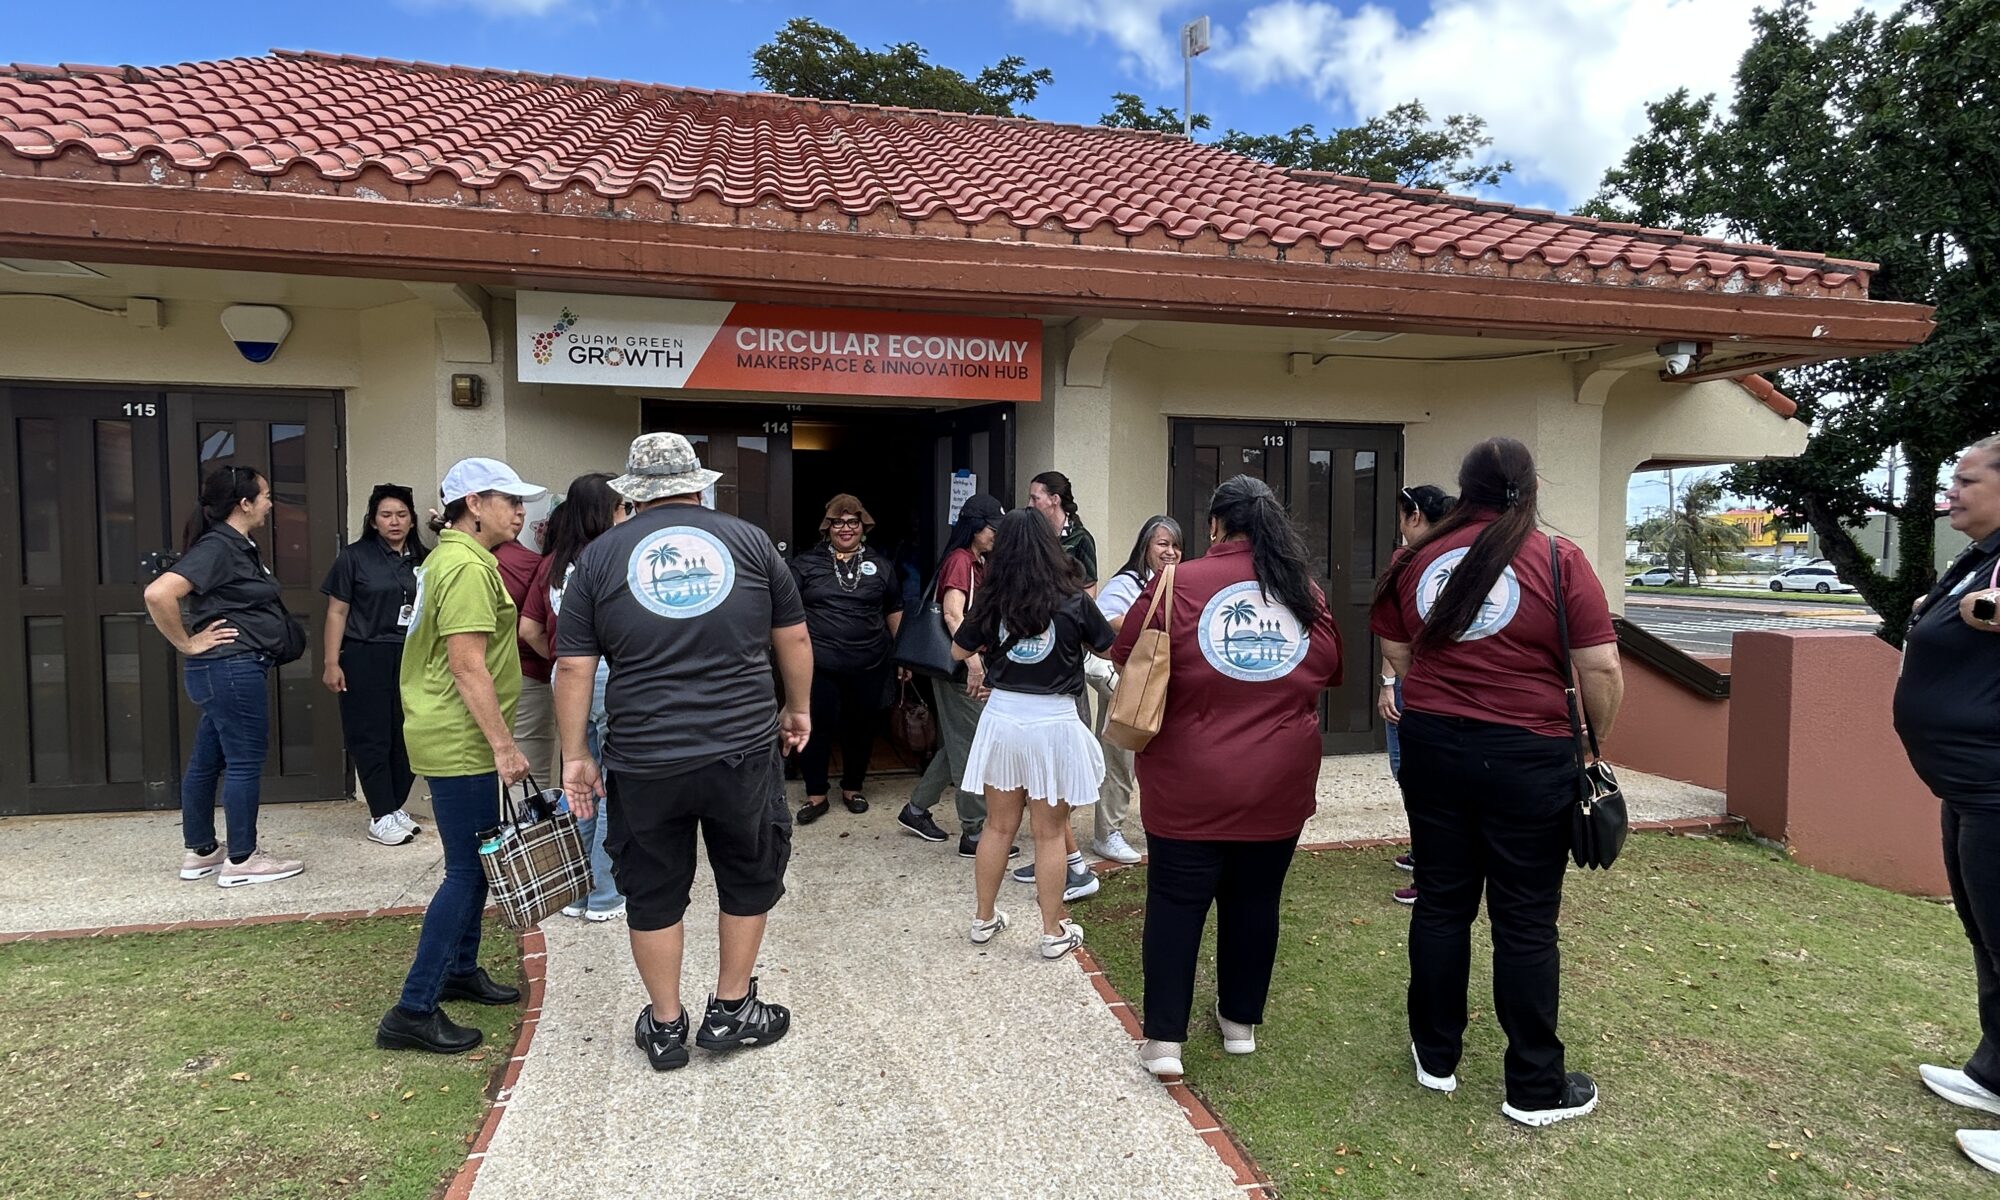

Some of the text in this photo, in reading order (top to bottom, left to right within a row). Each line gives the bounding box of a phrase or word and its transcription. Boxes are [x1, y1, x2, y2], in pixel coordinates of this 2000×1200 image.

[568, 333, 683, 348] GUAM GREEN
[735, 327, 1029, 363] CIRCULAR ECONOMY
[568, 345, 683, 368] GROWTH
[736, 353, 1029, 380] MAKERSPACE & INNOVATION HUB
[123, 403, 156, 416] 115
[786, 404, 802, 412] 114
[762, 421, 789, 433] 114
[1263, 435, 1284, 446] 113
